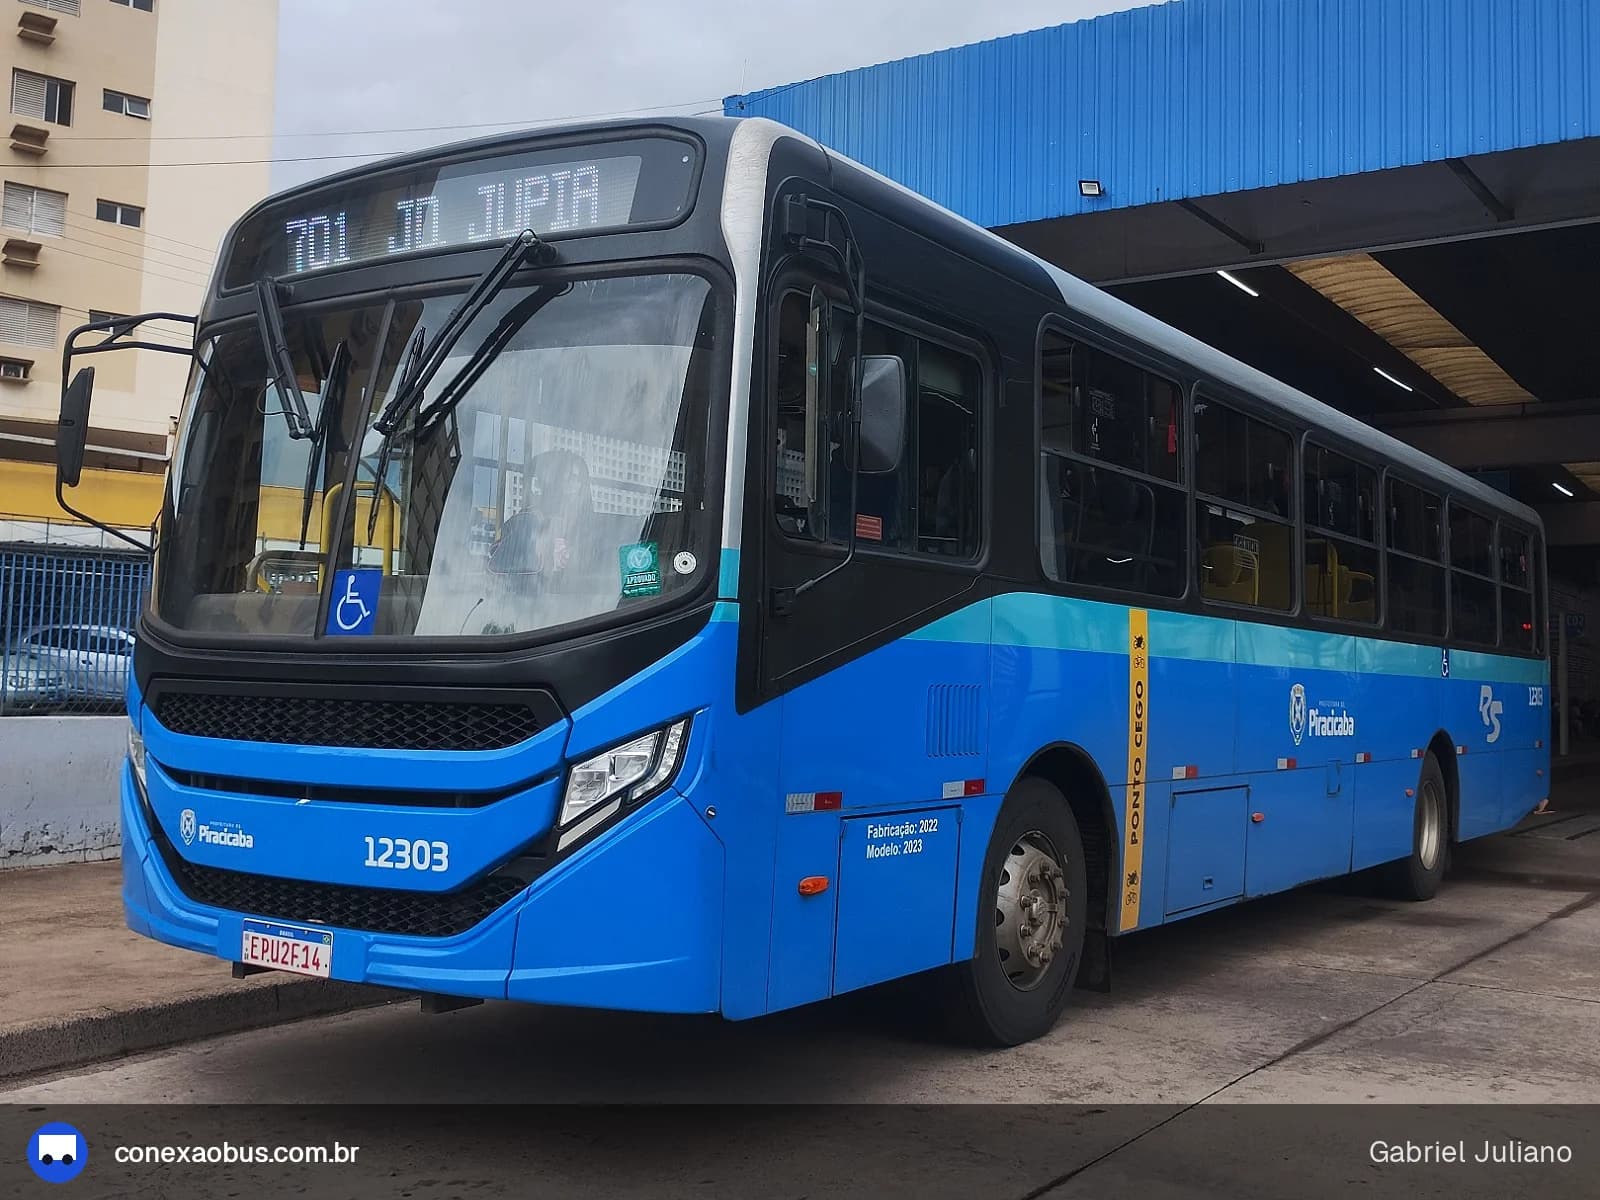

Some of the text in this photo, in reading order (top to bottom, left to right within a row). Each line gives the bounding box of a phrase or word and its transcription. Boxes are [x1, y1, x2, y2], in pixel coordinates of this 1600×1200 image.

[286, 212, 350, 272] 701
[626, 573, 656, 585] APROVADO
[1309, 708, 1354, 737] Piracicaba
[1130, 680, 1144, 845] PONTO CEGO
[199, 824, 254, 849] Piracicaba
[867, 818, 938, 840] Fabricação: 2022
[364, 836, 449, 872] 12303
[866, 838, 923, 859] Modelo: 2023
[250, 935, 321, 971] EPU2F14
